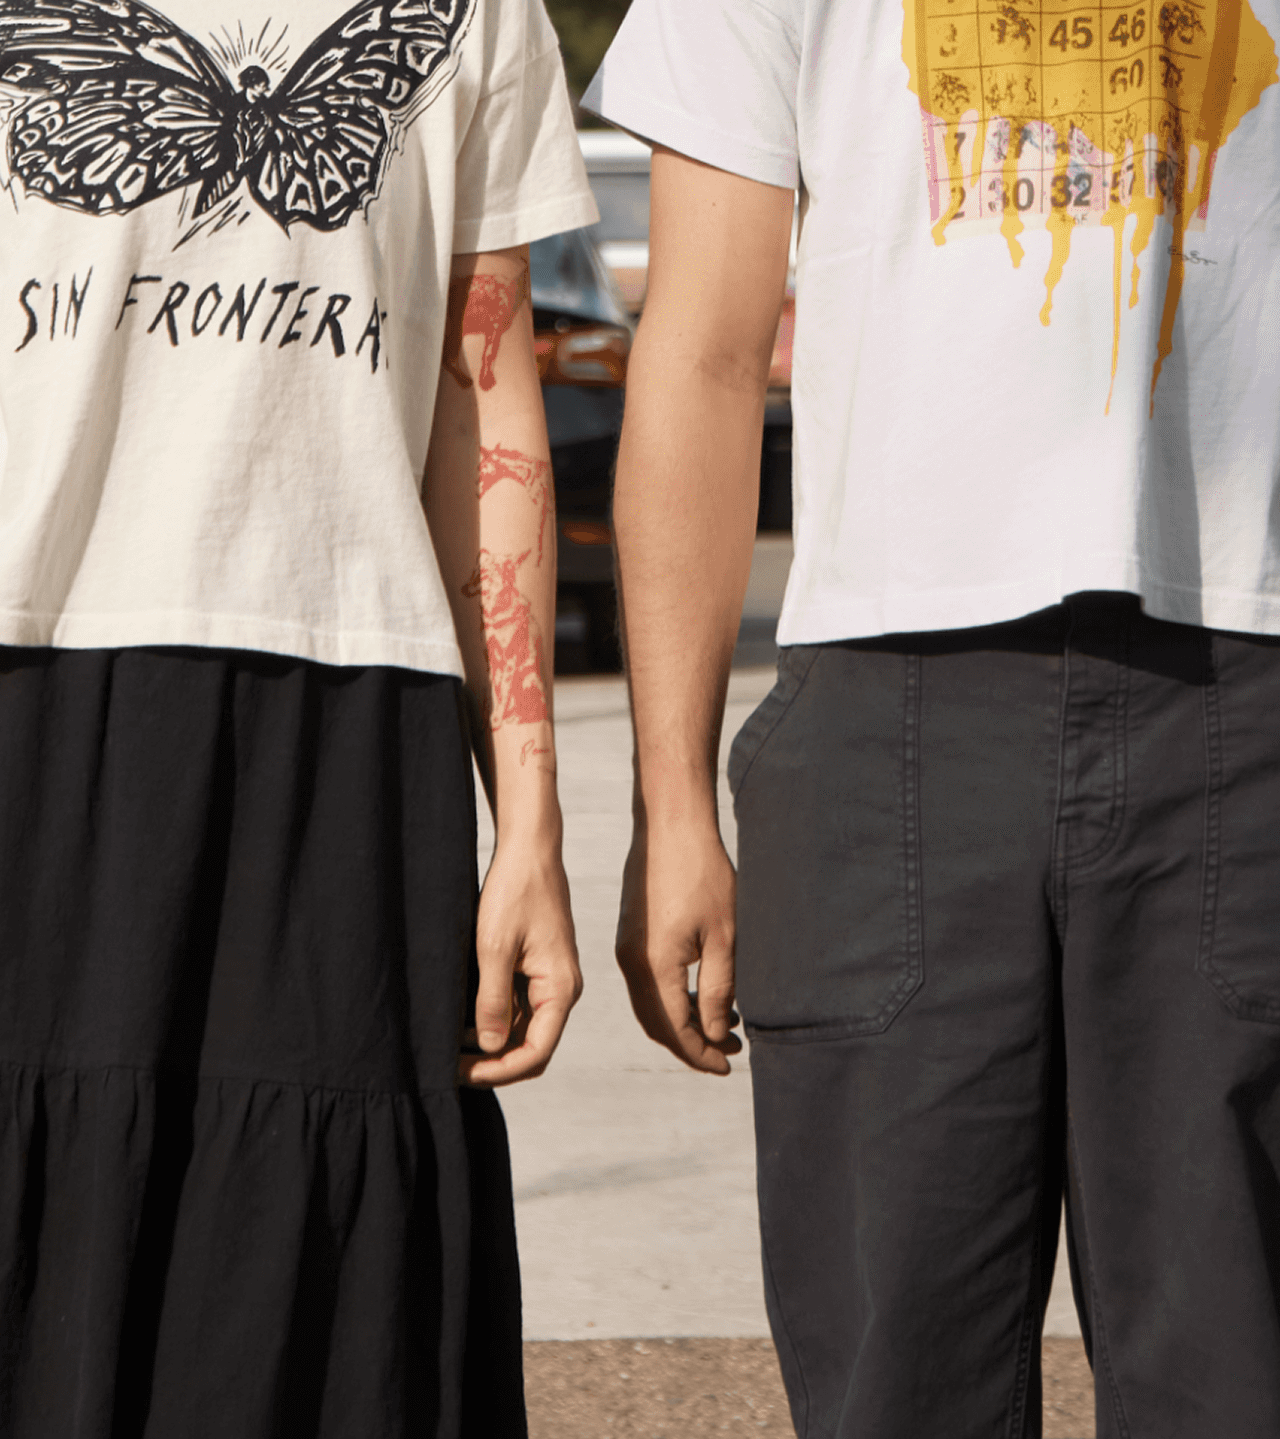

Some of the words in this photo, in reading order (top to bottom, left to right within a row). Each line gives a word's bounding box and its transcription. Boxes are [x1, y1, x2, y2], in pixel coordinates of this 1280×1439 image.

[1049, 16, 1094, 53] 45
[1109, 8, 1146, 47] 46
[1050, 172, 1094, 207] 32
[15, 265, 93, 352] SIN
[114, 273, 389, 375] FRONTERA
